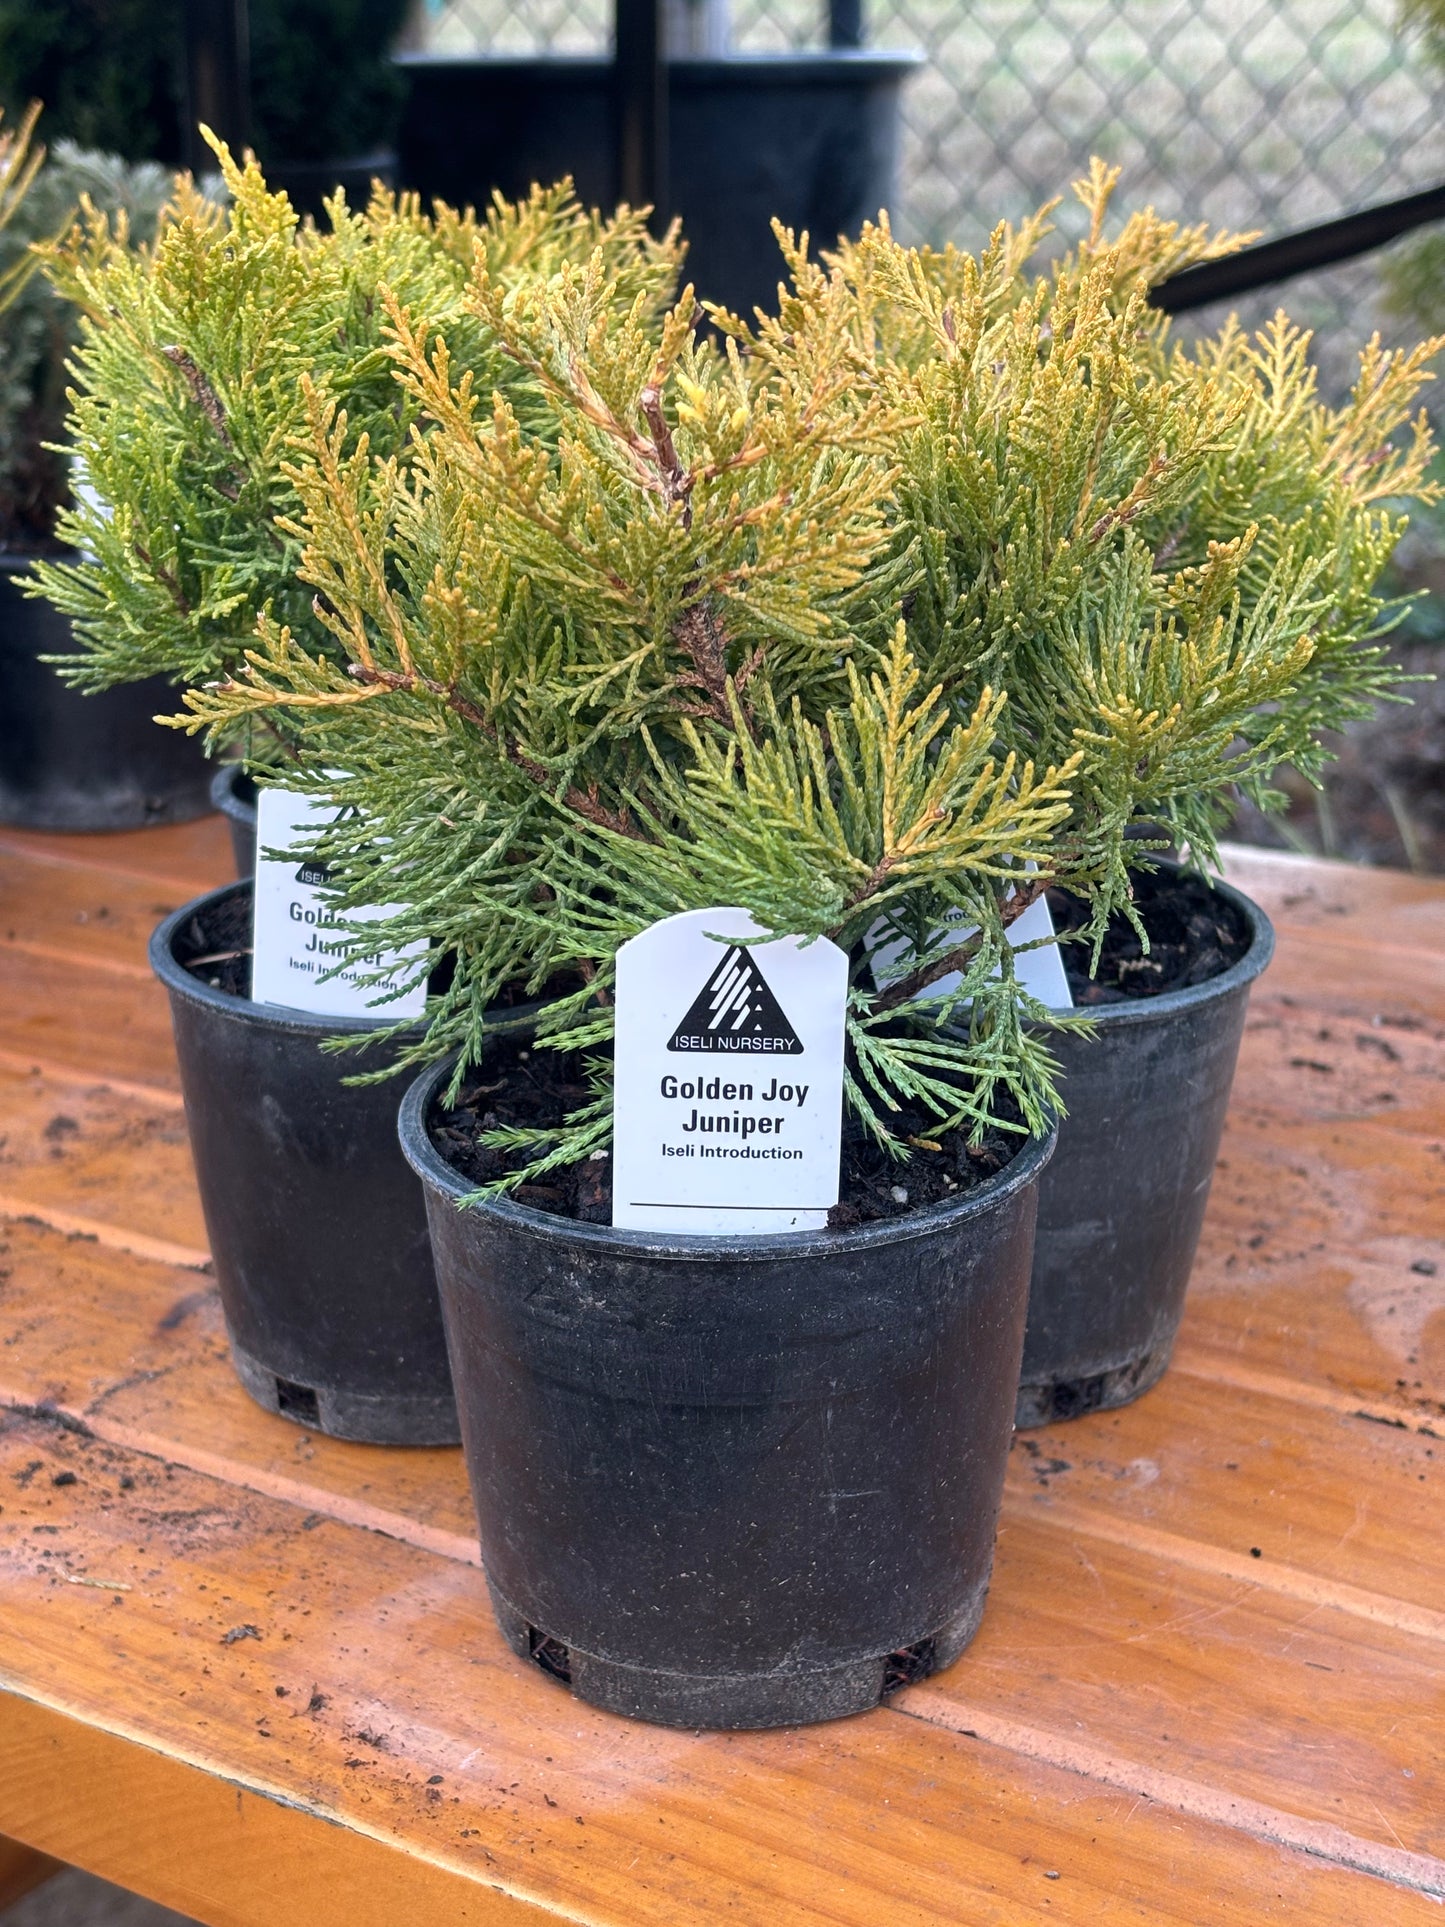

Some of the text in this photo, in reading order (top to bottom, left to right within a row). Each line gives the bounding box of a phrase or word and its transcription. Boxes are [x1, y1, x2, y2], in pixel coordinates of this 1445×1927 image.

[289, 901, 357, 928] Gold
[289, 956, 314, 973] Iseli
[675, 1035, 796, 1051] ISELI NURSERY
[660, 1075, 810, 1107] Golden Joy
[682, 1109, 785, 1139] Juniper
[661, 1143, 803, 1160] Iseli Introduction
